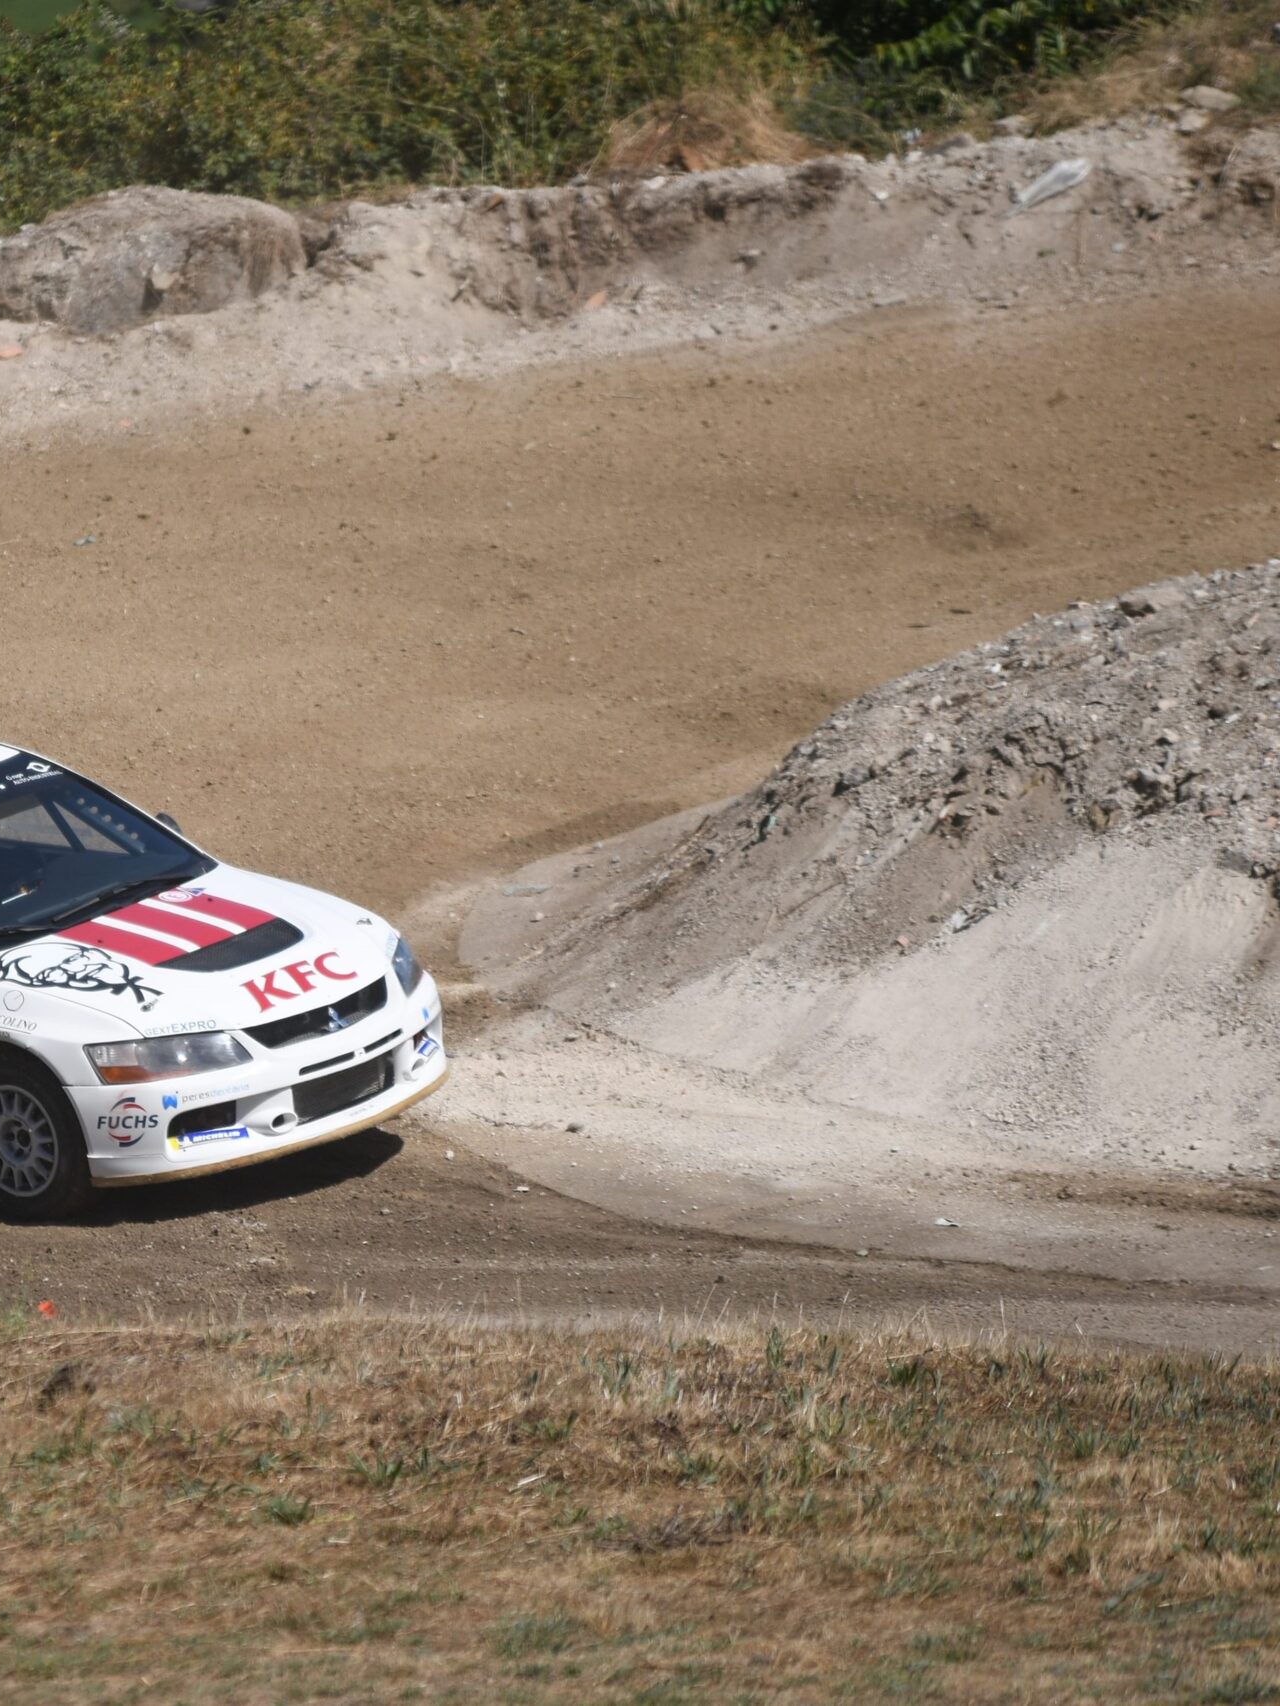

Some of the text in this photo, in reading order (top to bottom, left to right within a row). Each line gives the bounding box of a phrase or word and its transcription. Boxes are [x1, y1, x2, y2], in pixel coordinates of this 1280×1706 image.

[238, 951, 359, 1013] KFC
[96, 1114, 159, 1130] FUCHS
[192, 1130, 242, 1144] MICHELIN
